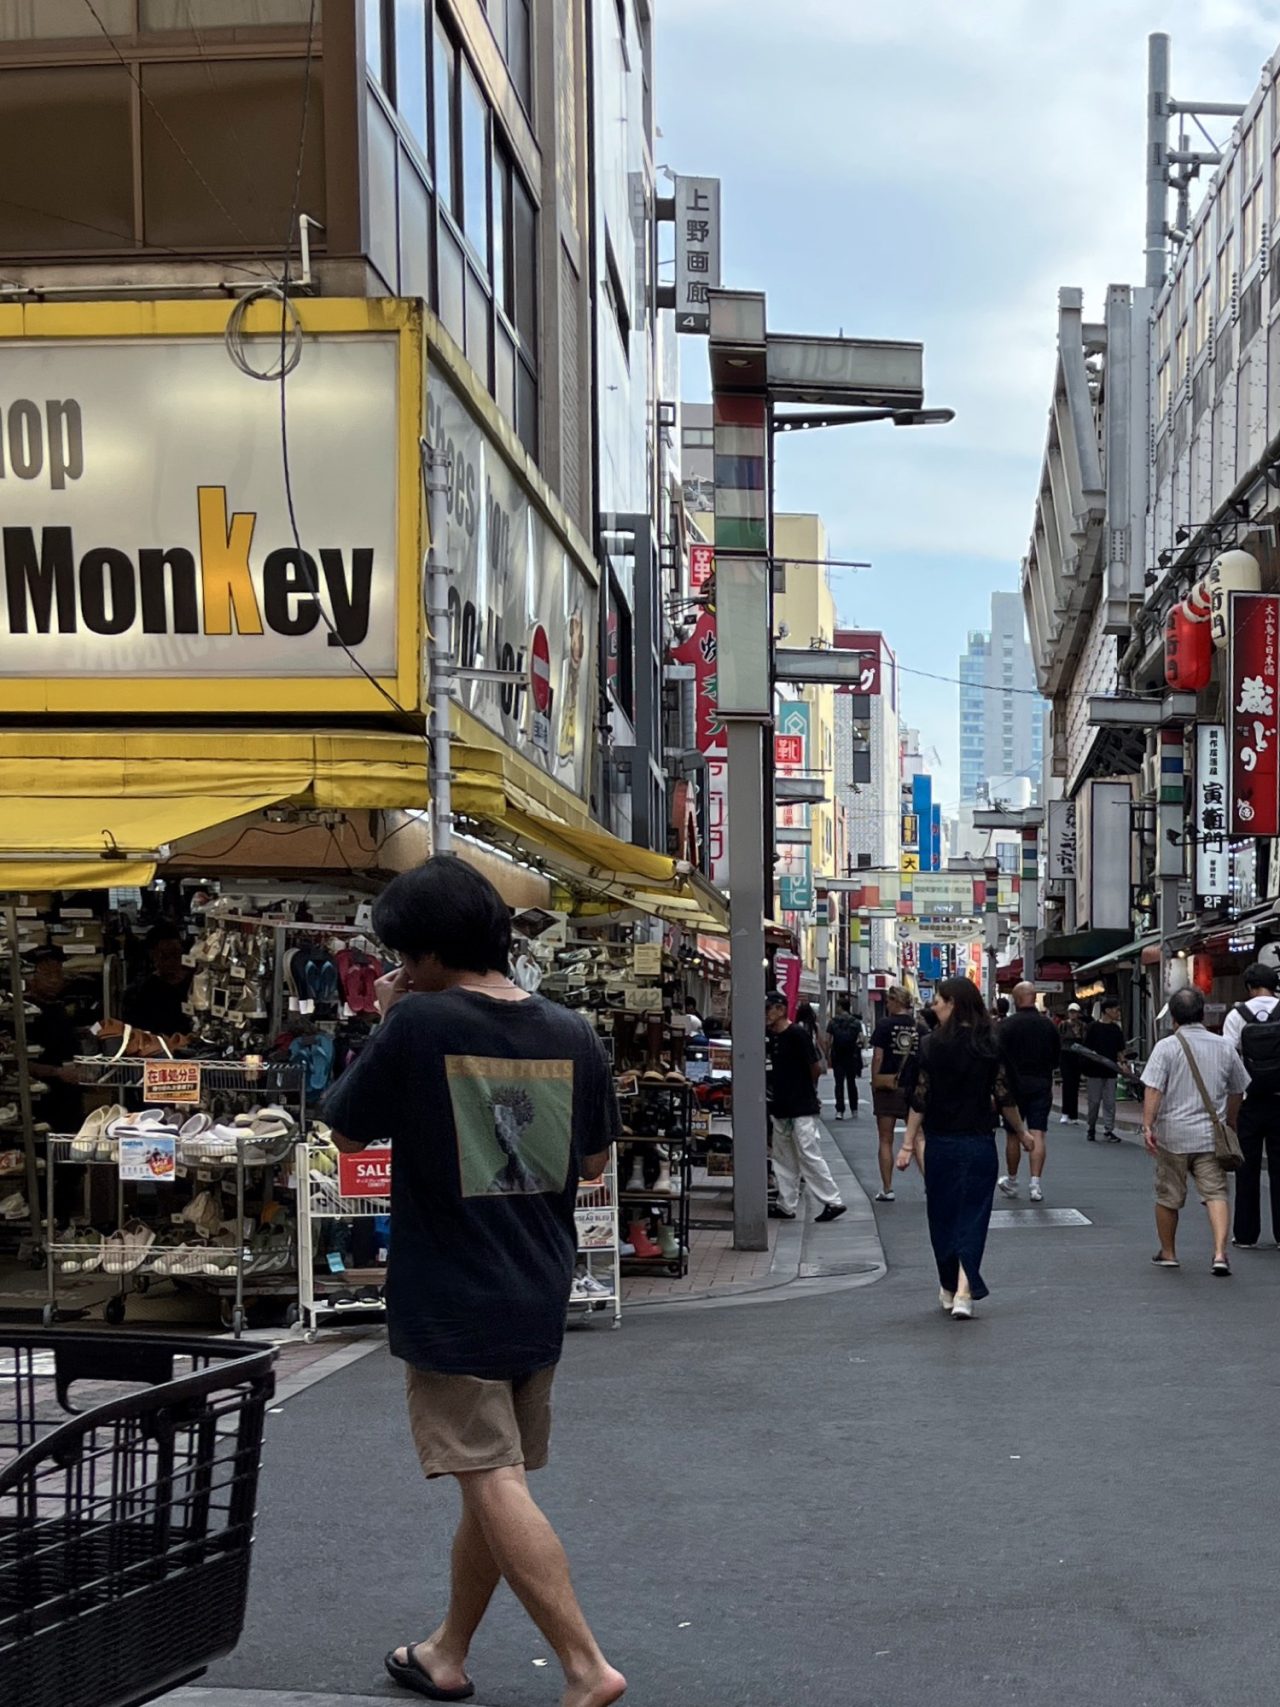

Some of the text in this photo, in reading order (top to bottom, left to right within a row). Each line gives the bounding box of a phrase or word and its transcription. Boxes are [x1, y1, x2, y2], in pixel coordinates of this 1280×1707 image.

[686, 188, 710, 304] 上野画廊
[0, 398, 84, 490] op
[3, 486, 374, 645] Monkey
[1203, 895, 1222, 909] 2F
[356, 1163, 392, 1177] SALE
